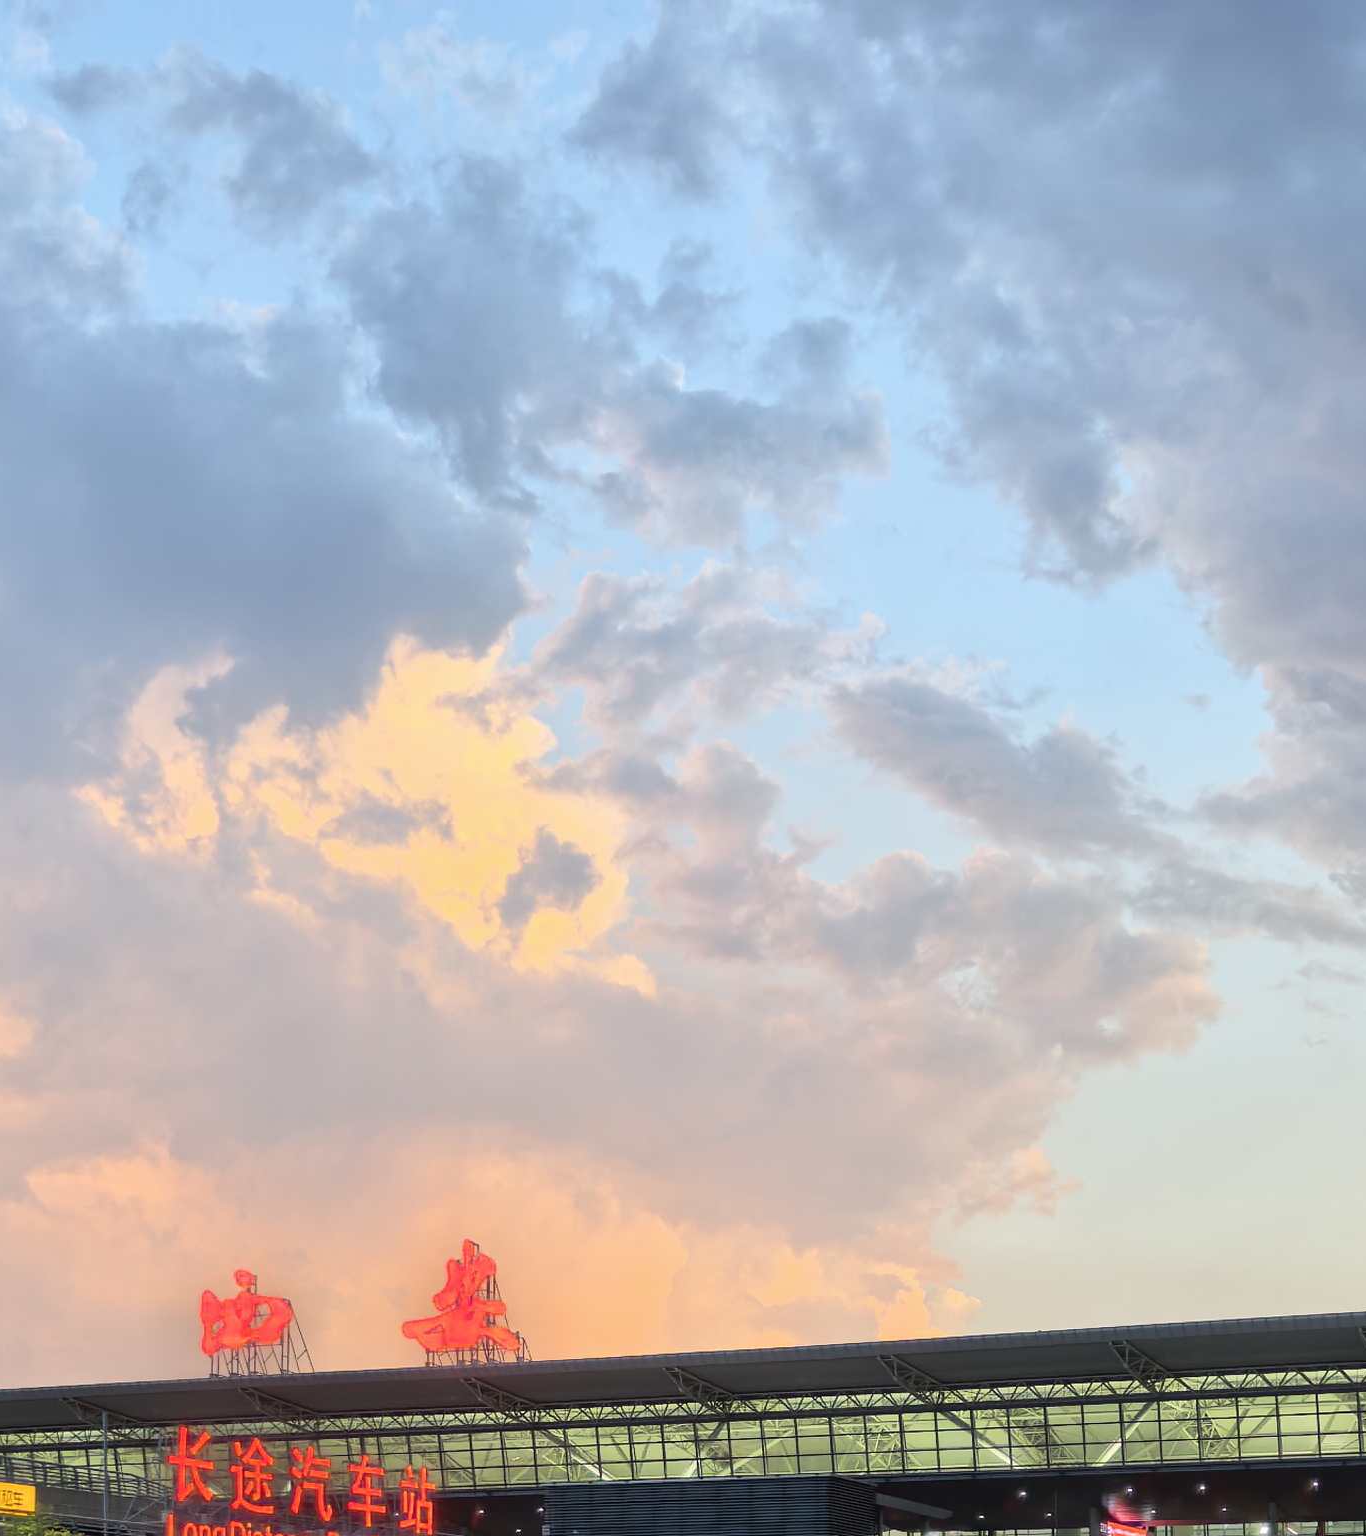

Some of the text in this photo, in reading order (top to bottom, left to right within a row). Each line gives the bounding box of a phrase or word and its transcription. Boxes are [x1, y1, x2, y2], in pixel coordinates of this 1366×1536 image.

[167, 1425, 435, 1535] 长途汽车站
